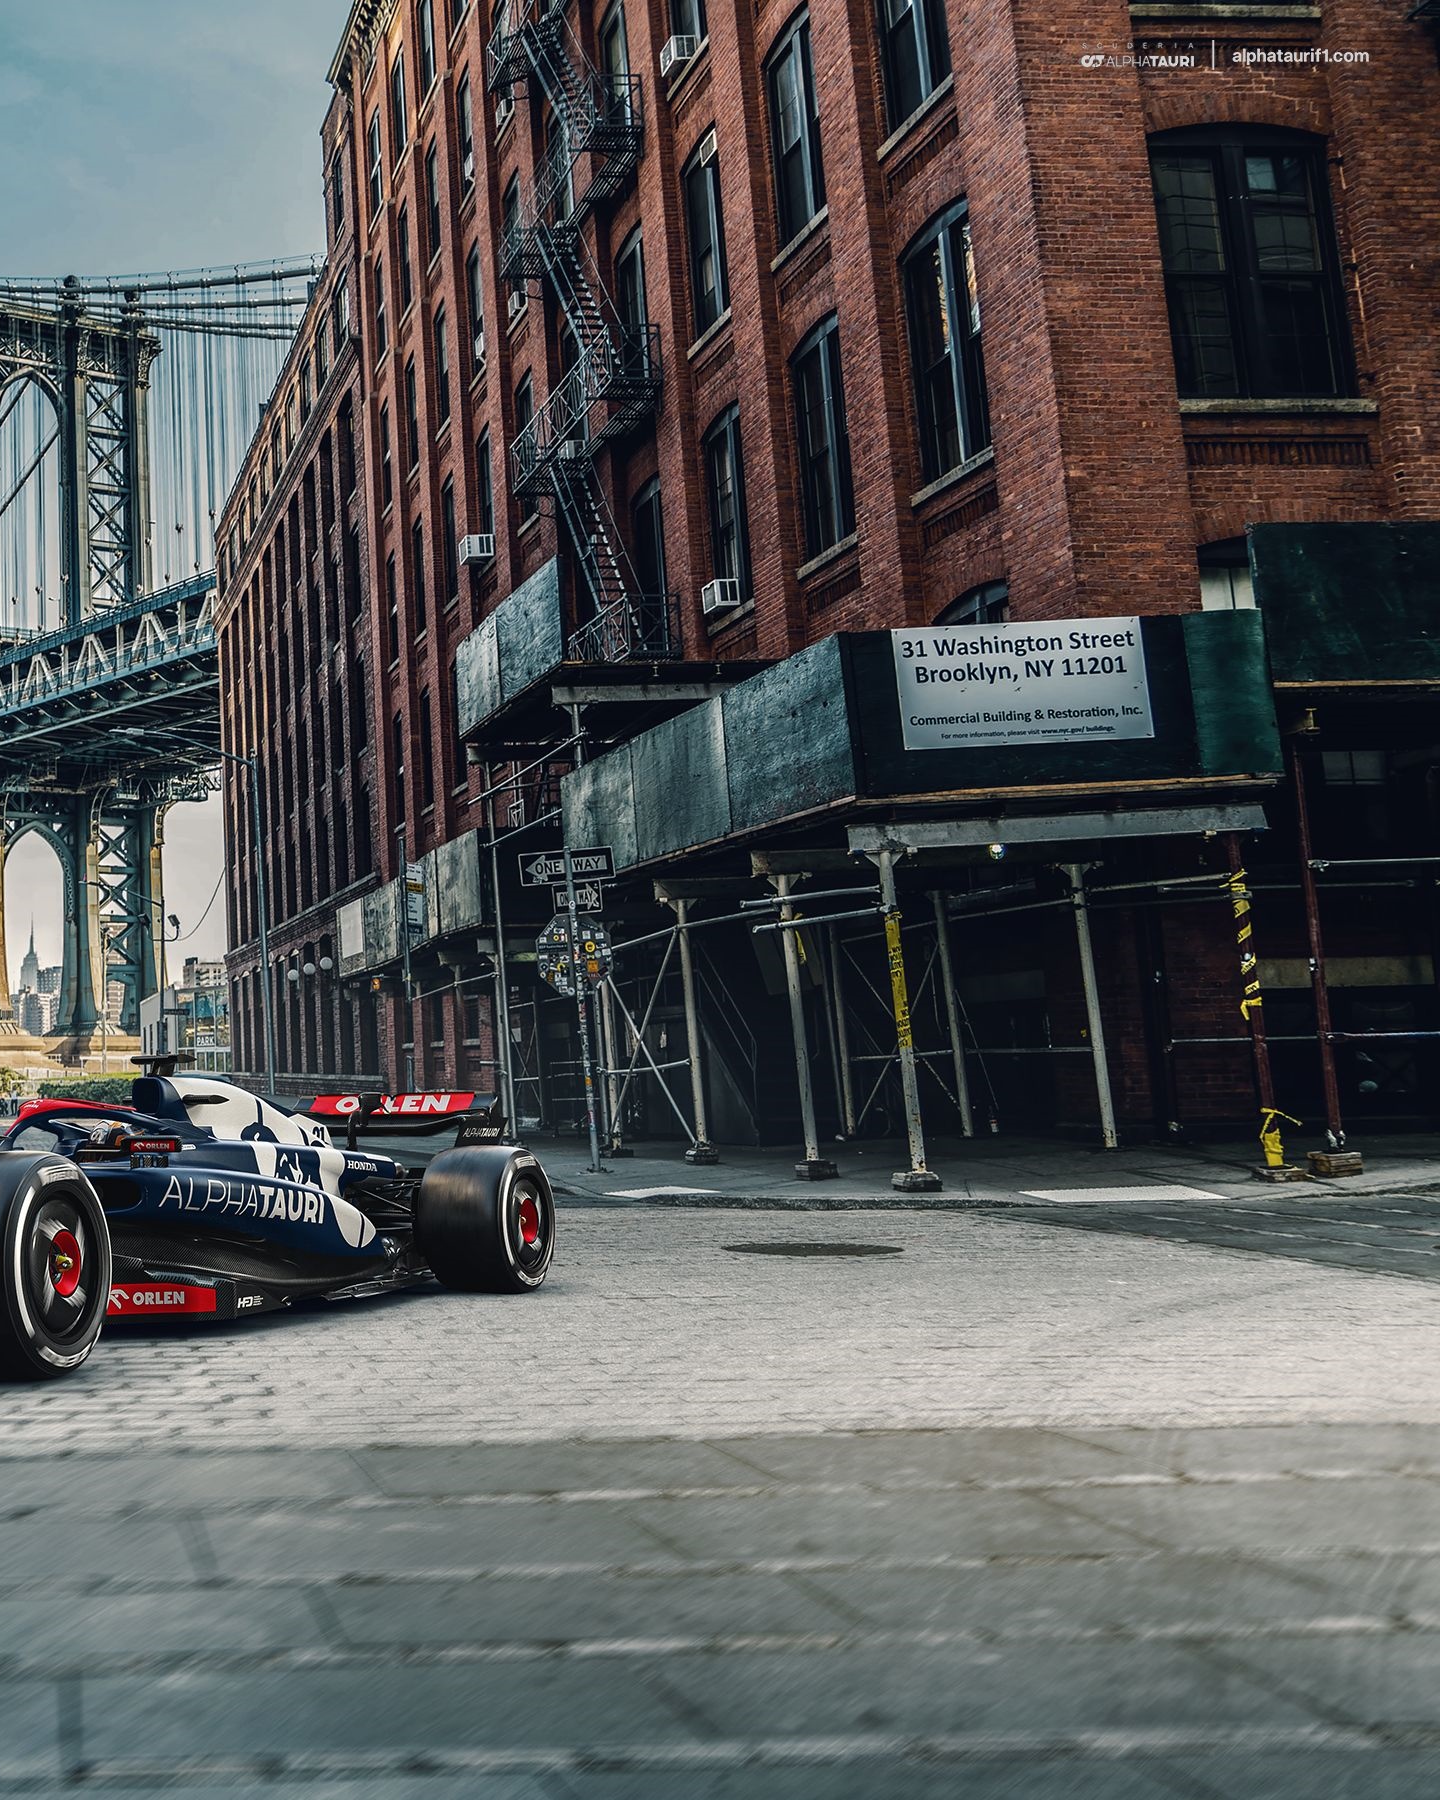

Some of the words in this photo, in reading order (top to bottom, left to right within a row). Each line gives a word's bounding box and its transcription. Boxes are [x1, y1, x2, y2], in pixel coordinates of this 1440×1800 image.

[900, 639, 928, 659] 31
[933, 634, 1063, 658] Washington
[1069, 630, 1135, 650] Street
[915, 662, 1020, 684] Brooklyn,
[1025, 659, 1055, 678] NY
[1062, 656, 1128, 676] 11201
[910, 712, 981, 726] Commercial
[983, 709, 1032, 725] Building
[1034, 709, 1045, 720] &
[1047, 706, 1120, 720] Restoration,
[1121, 704, 1144, 716] Inc.
[969, 730, 1006, 739] information,
[1007, 730, 1027, 738] please
[535, 862, 562, 874] ONE
[573, 857, 600, 870] WAY
[578, 890, 594, 903] WAY
[196, 1036, 215, 1046] PARK
[335, 1095, 450, 1113] OLEN
[462, 1127, 501, 1138] ALPHATAURI
[146, 1142, 170, 1150] ORLEN
[347, 1160, 378, 1172] HONDA
[159, 1175, 325, 1225] ALPHATAURI
[132, 1290, 186, 1306] ORLEN
